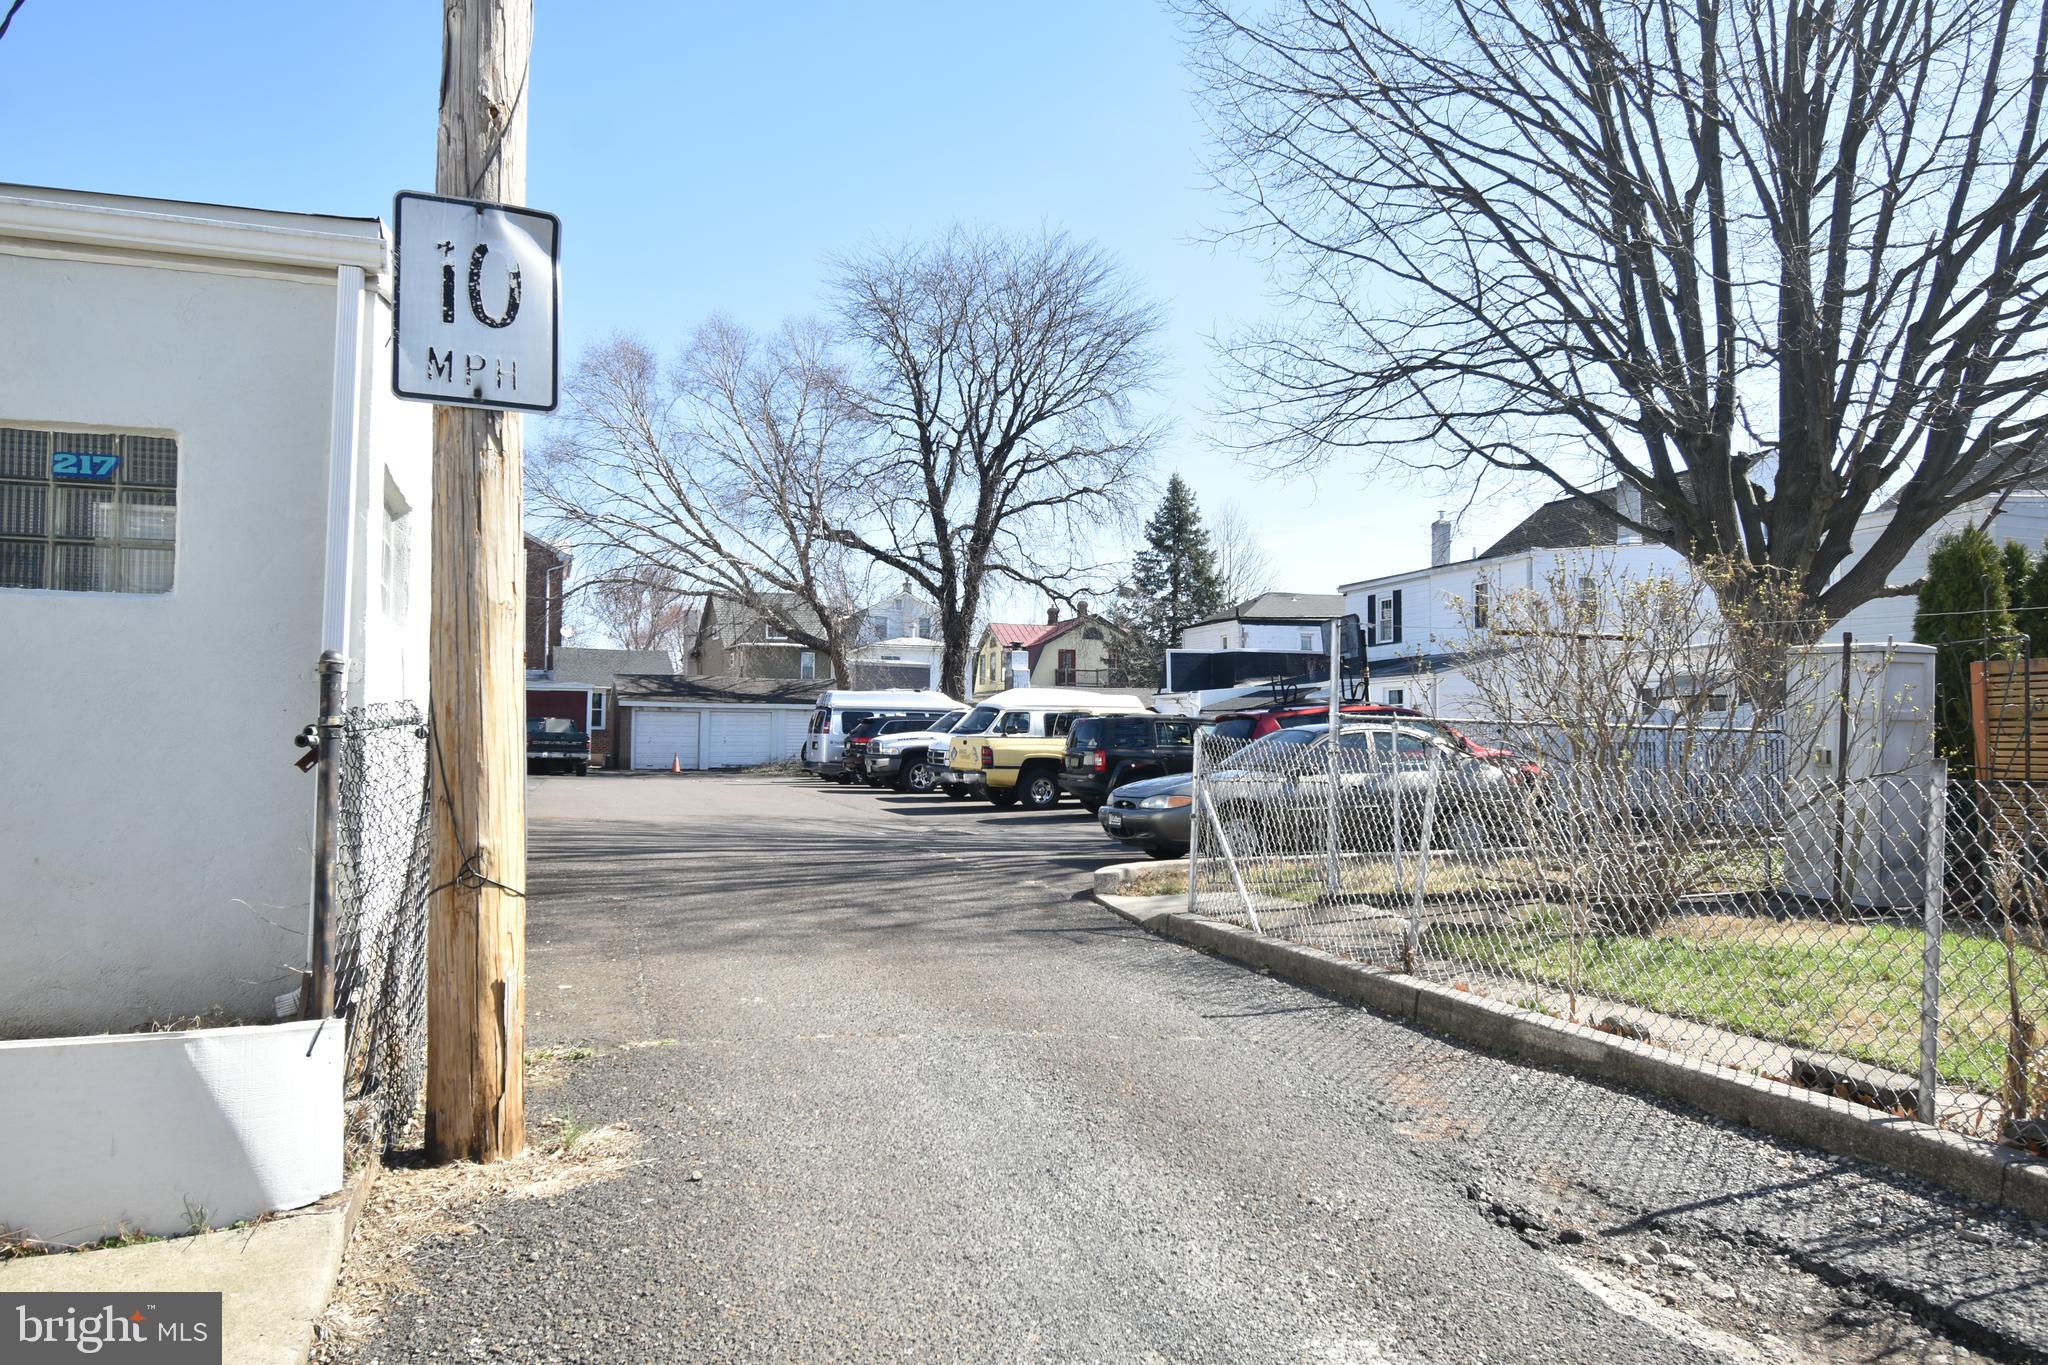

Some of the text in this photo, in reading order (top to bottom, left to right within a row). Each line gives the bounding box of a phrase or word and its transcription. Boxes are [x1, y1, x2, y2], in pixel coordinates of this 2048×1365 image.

[437, 240, 522, 329] 10
[426, 346, 517, 391] MPH
[53, 453, 118, 475] 217
